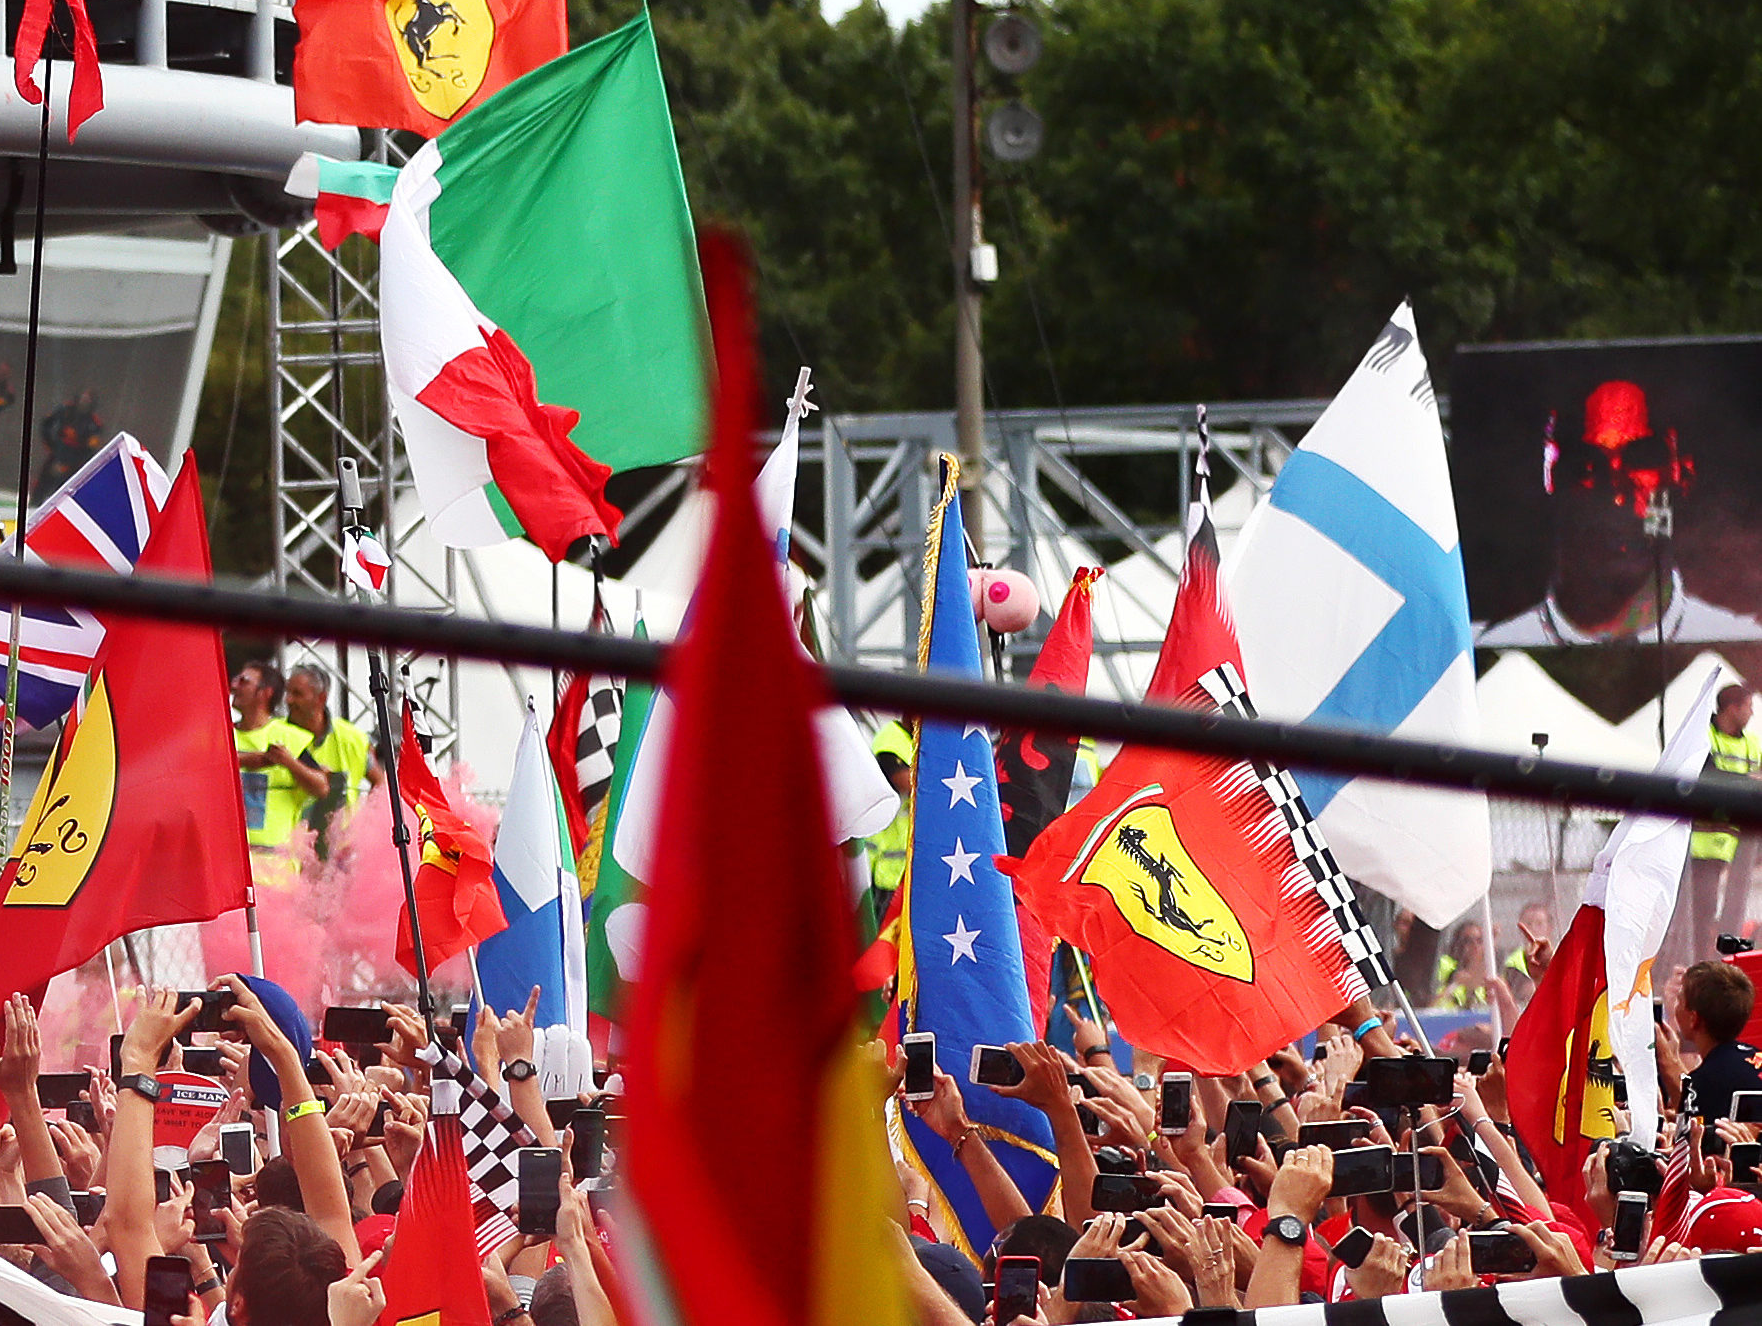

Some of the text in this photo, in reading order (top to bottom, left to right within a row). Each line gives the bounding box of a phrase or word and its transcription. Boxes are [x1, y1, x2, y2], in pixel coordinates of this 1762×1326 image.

[0, 718, 15, 787] 1000
[176, 1090, 224, 1102] ICE MAN
